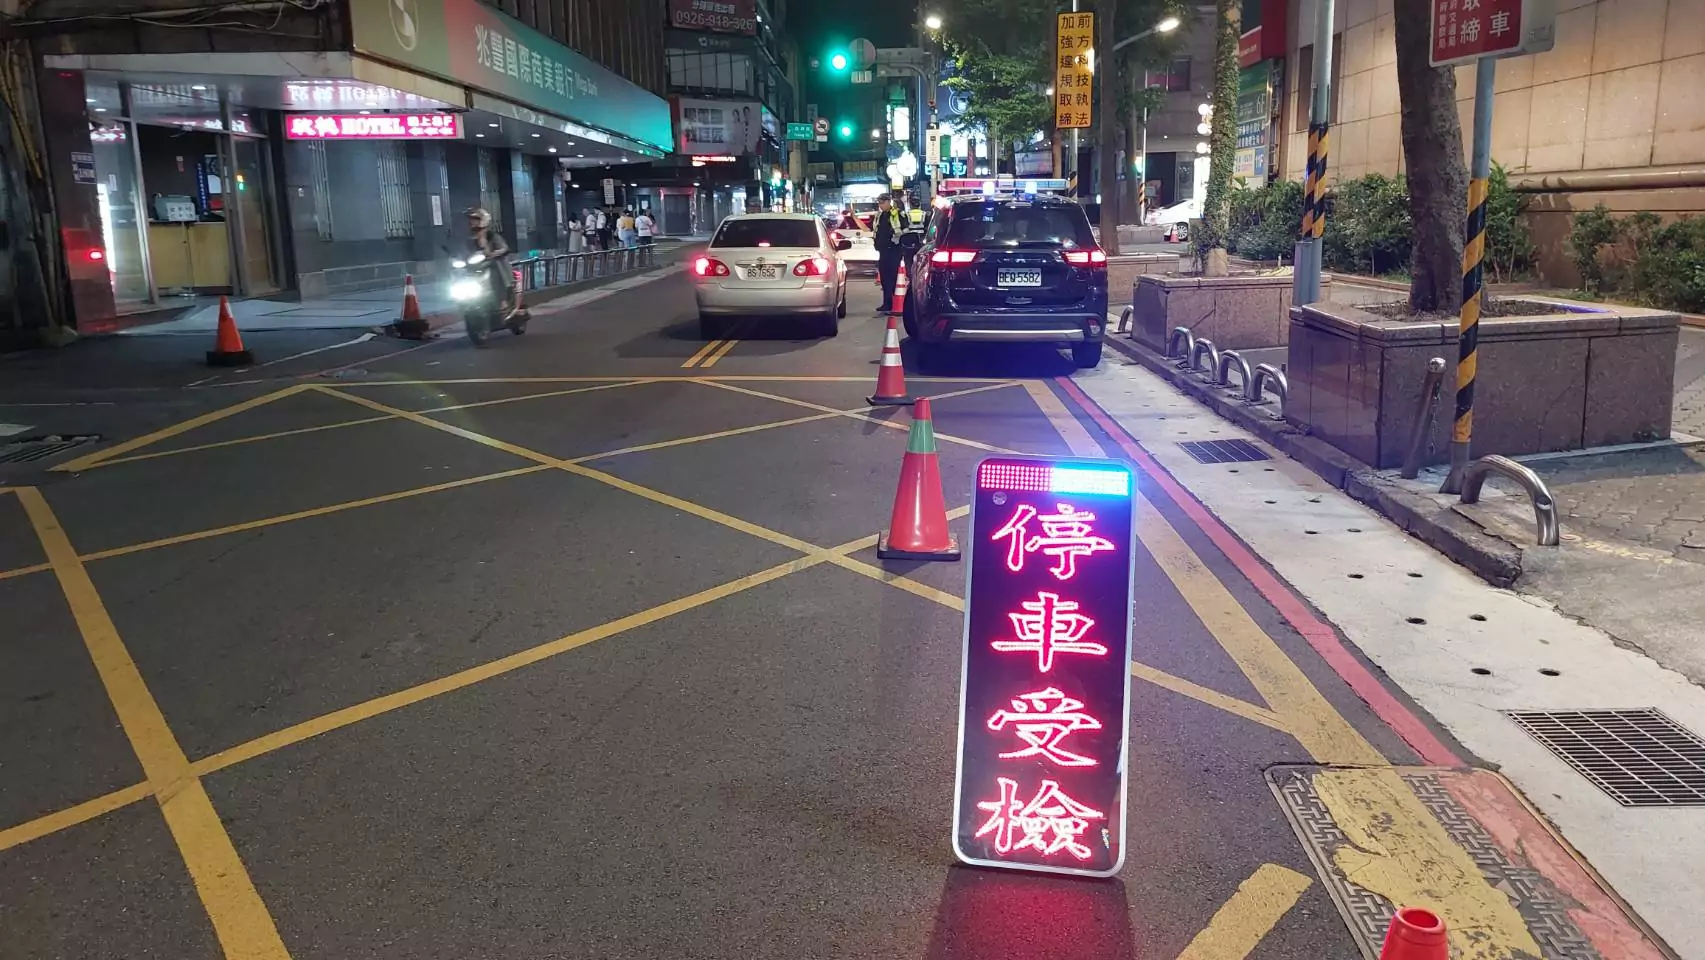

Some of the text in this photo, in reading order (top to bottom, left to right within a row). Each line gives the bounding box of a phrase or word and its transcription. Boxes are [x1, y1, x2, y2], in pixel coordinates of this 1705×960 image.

[1059, 16, 1075, 126] 加強違規取締
[1075, 15, 1091, 125] 前方科技執法
[1489, 11, 1510, 37] 車
[340, 117, 406, 135] HOTEL
[976, 503, 1115, 861] 停車受檢
